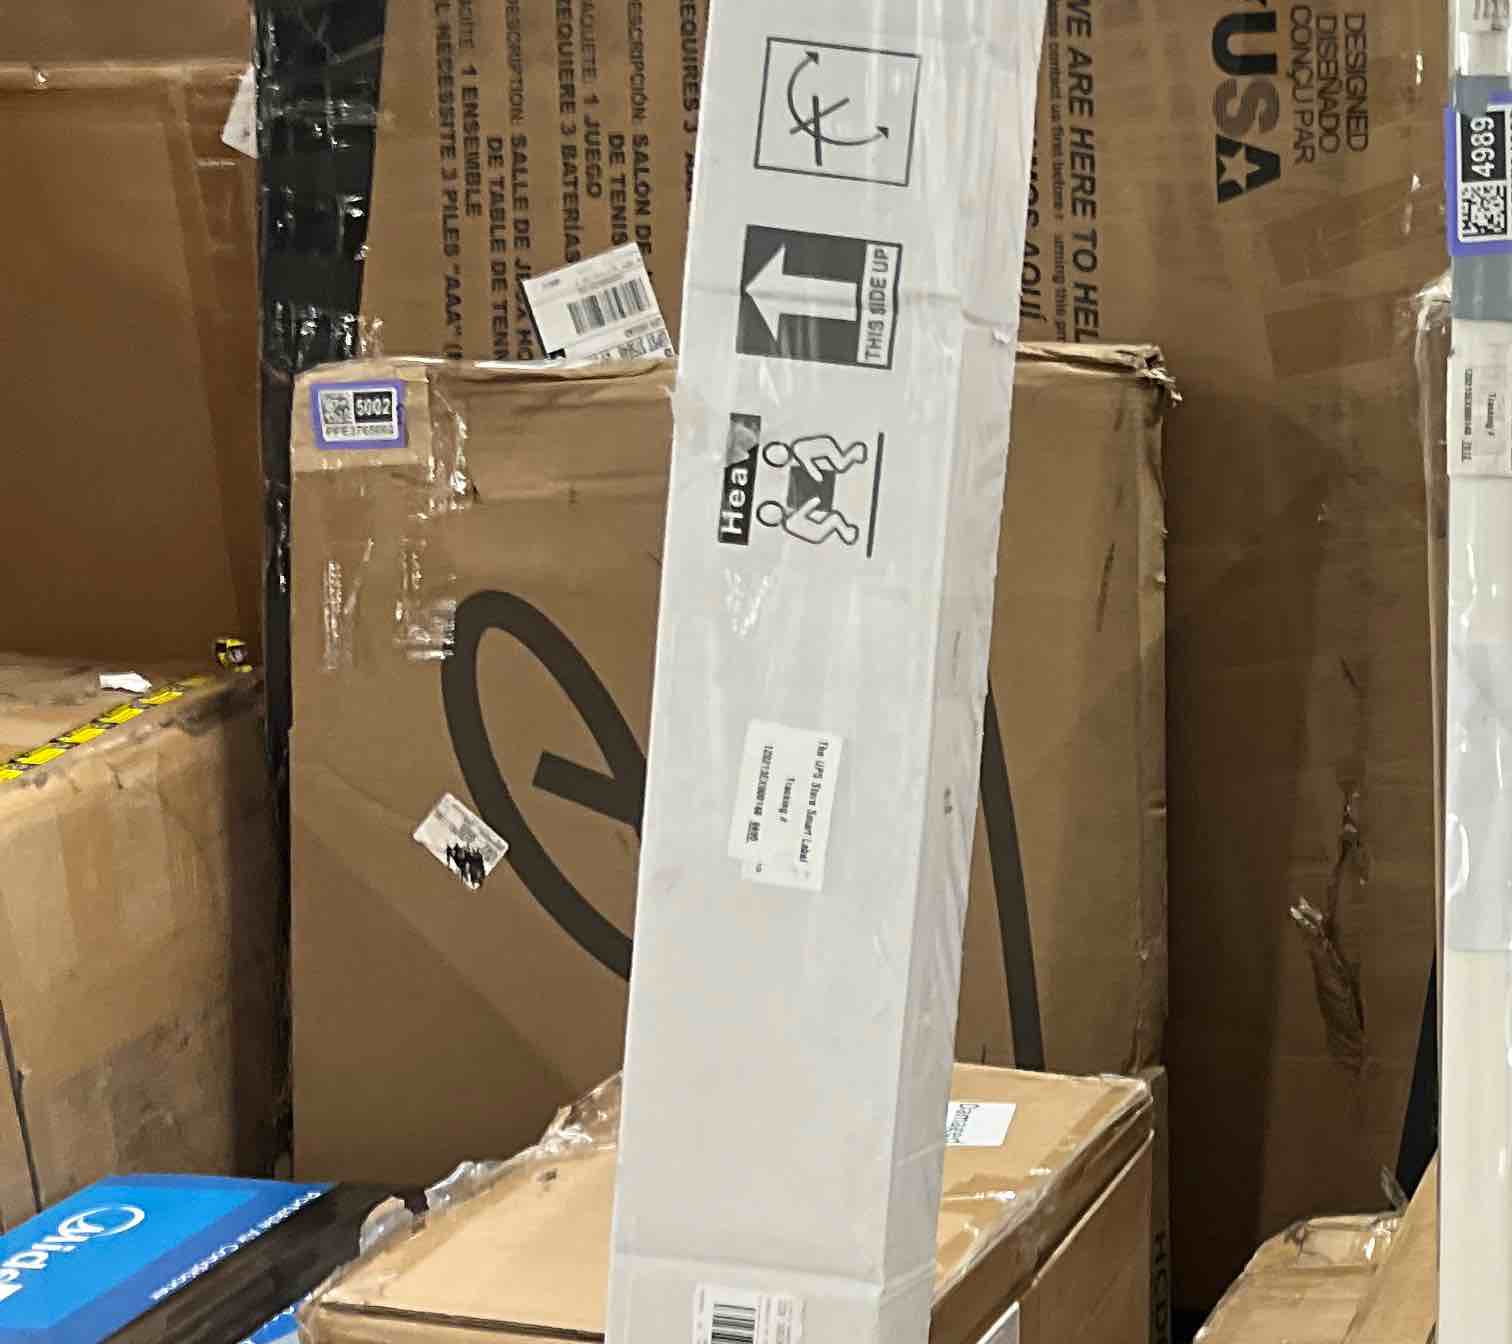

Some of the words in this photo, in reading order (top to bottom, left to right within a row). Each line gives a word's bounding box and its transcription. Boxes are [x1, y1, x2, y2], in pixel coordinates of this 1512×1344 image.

[461, 64, 478, 77] 1
[1288, 5, 1314, 105] CONÇU
[583, 93, 600, 106] 1
[1068, 47, 1095, 119] ARE
[1315, 15, 1343, 154] DISEÑADO
[1344, 13, 1369, 153] DESIGNED
[1212, 10, 1282, 205] USA
[561, 122, 577, 136] 3
[608, 133, 626, 165] DE
[1052, 126, 1064, 157] first
[1294, 109, 1316, 165] PAR
[1470, 116, 1495, 178] 4989
[462, 86, 483, 217] ENSEMBLE
[486, 136, 504, 169] DE
[584, 115, 603, 199] JUEGO
[441, 167, 457, 182] 3
[510, 134, 530, 211] SALLE
[632, 134, 652, 216] SALÓN
[1053, 160, 1065, 210] before
[1070, 126, 1097, 219] HERE
[489, 176, 506, 254] TABLE
[561, 144, 582, 263] BATERÍAS
[442, 190, 460, 258] PILES
[513, 218, 531, 249] DE
[871, 247, 889, 273] UP
[1072, 228, 1098, 273] TO
[491, 261, 508, 293] DE
[868, 276, 888, 316] SIDE
[1055, 287, 1066, 316] this
[865, 319, 885, 361] THIS
[355, 397, 392, 416] 5002
[816, 741, 829, 757] The
[812, 760, 825, 779] UPS
[778, 777, 796, 815] Tracking
[808, 781, 822, 807] Store
[804, 809, 817, 837] Smart
[799, 838, 812, 863] Label
